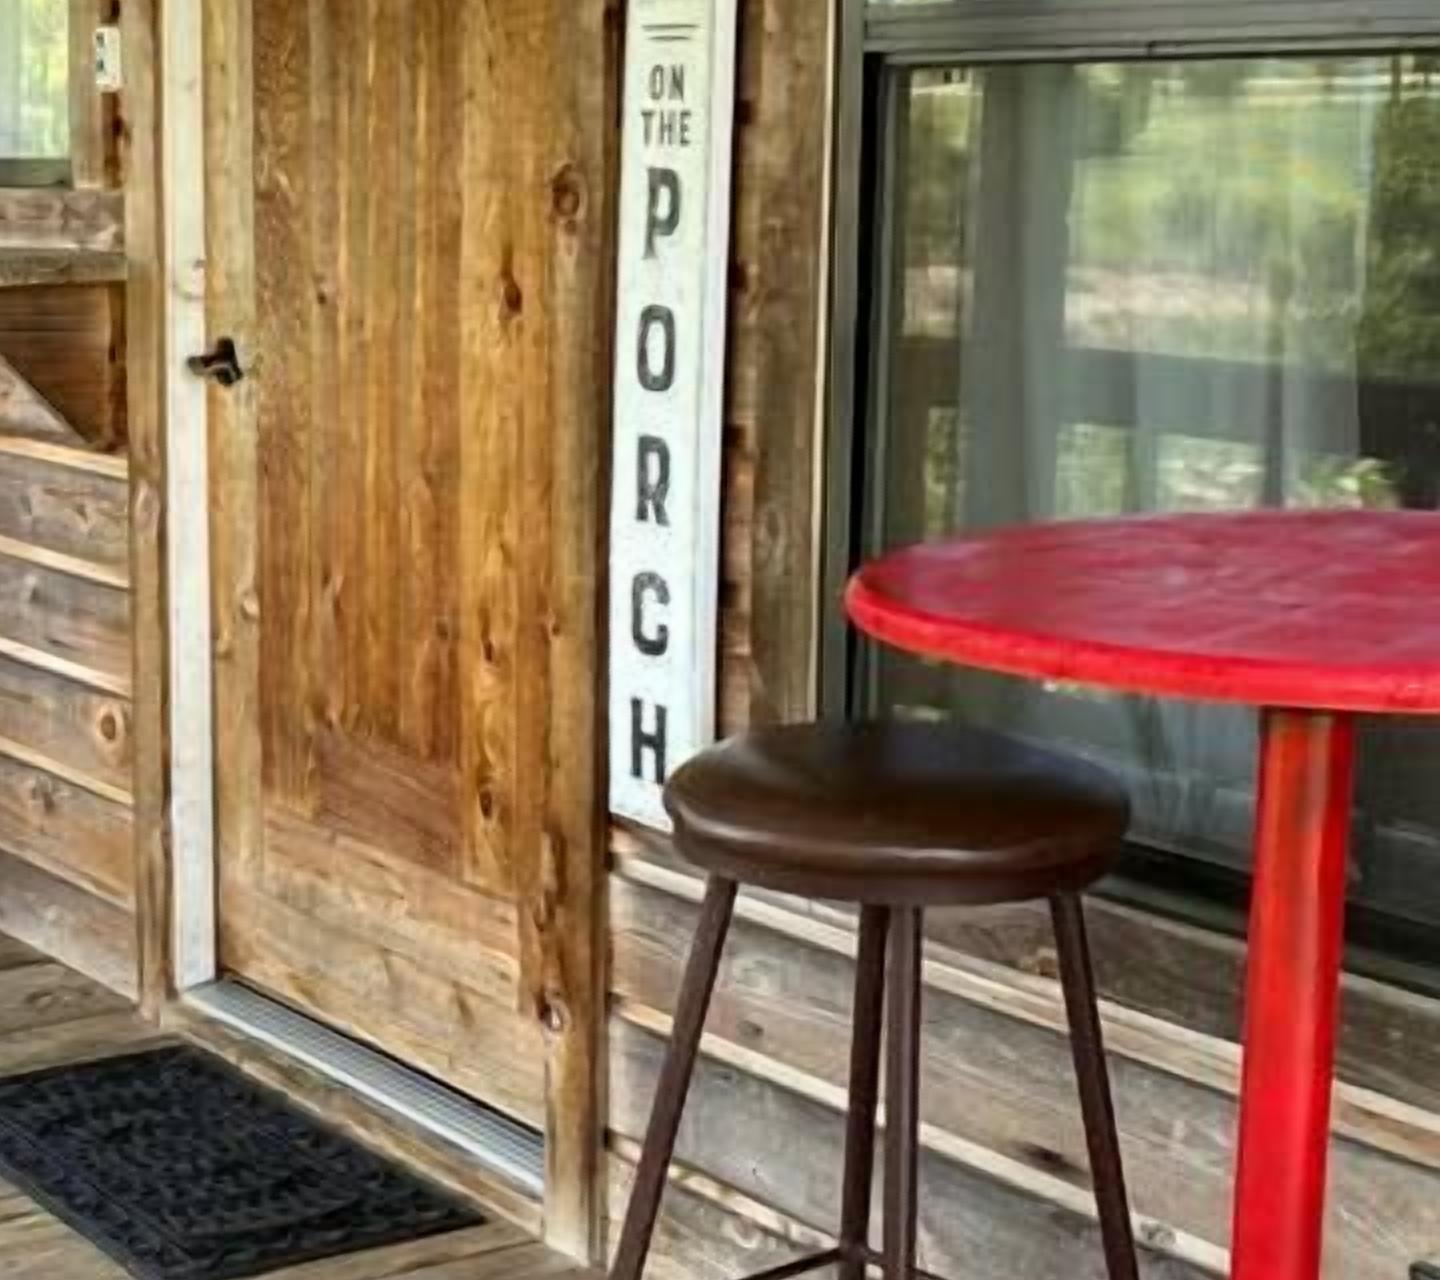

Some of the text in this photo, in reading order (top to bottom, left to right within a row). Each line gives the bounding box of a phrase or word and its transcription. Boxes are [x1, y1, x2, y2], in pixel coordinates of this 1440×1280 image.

[649, 64, 685, 102] ON
[640, 109, 692, 147] THE
[630, 167, 682, 786] PORCH
